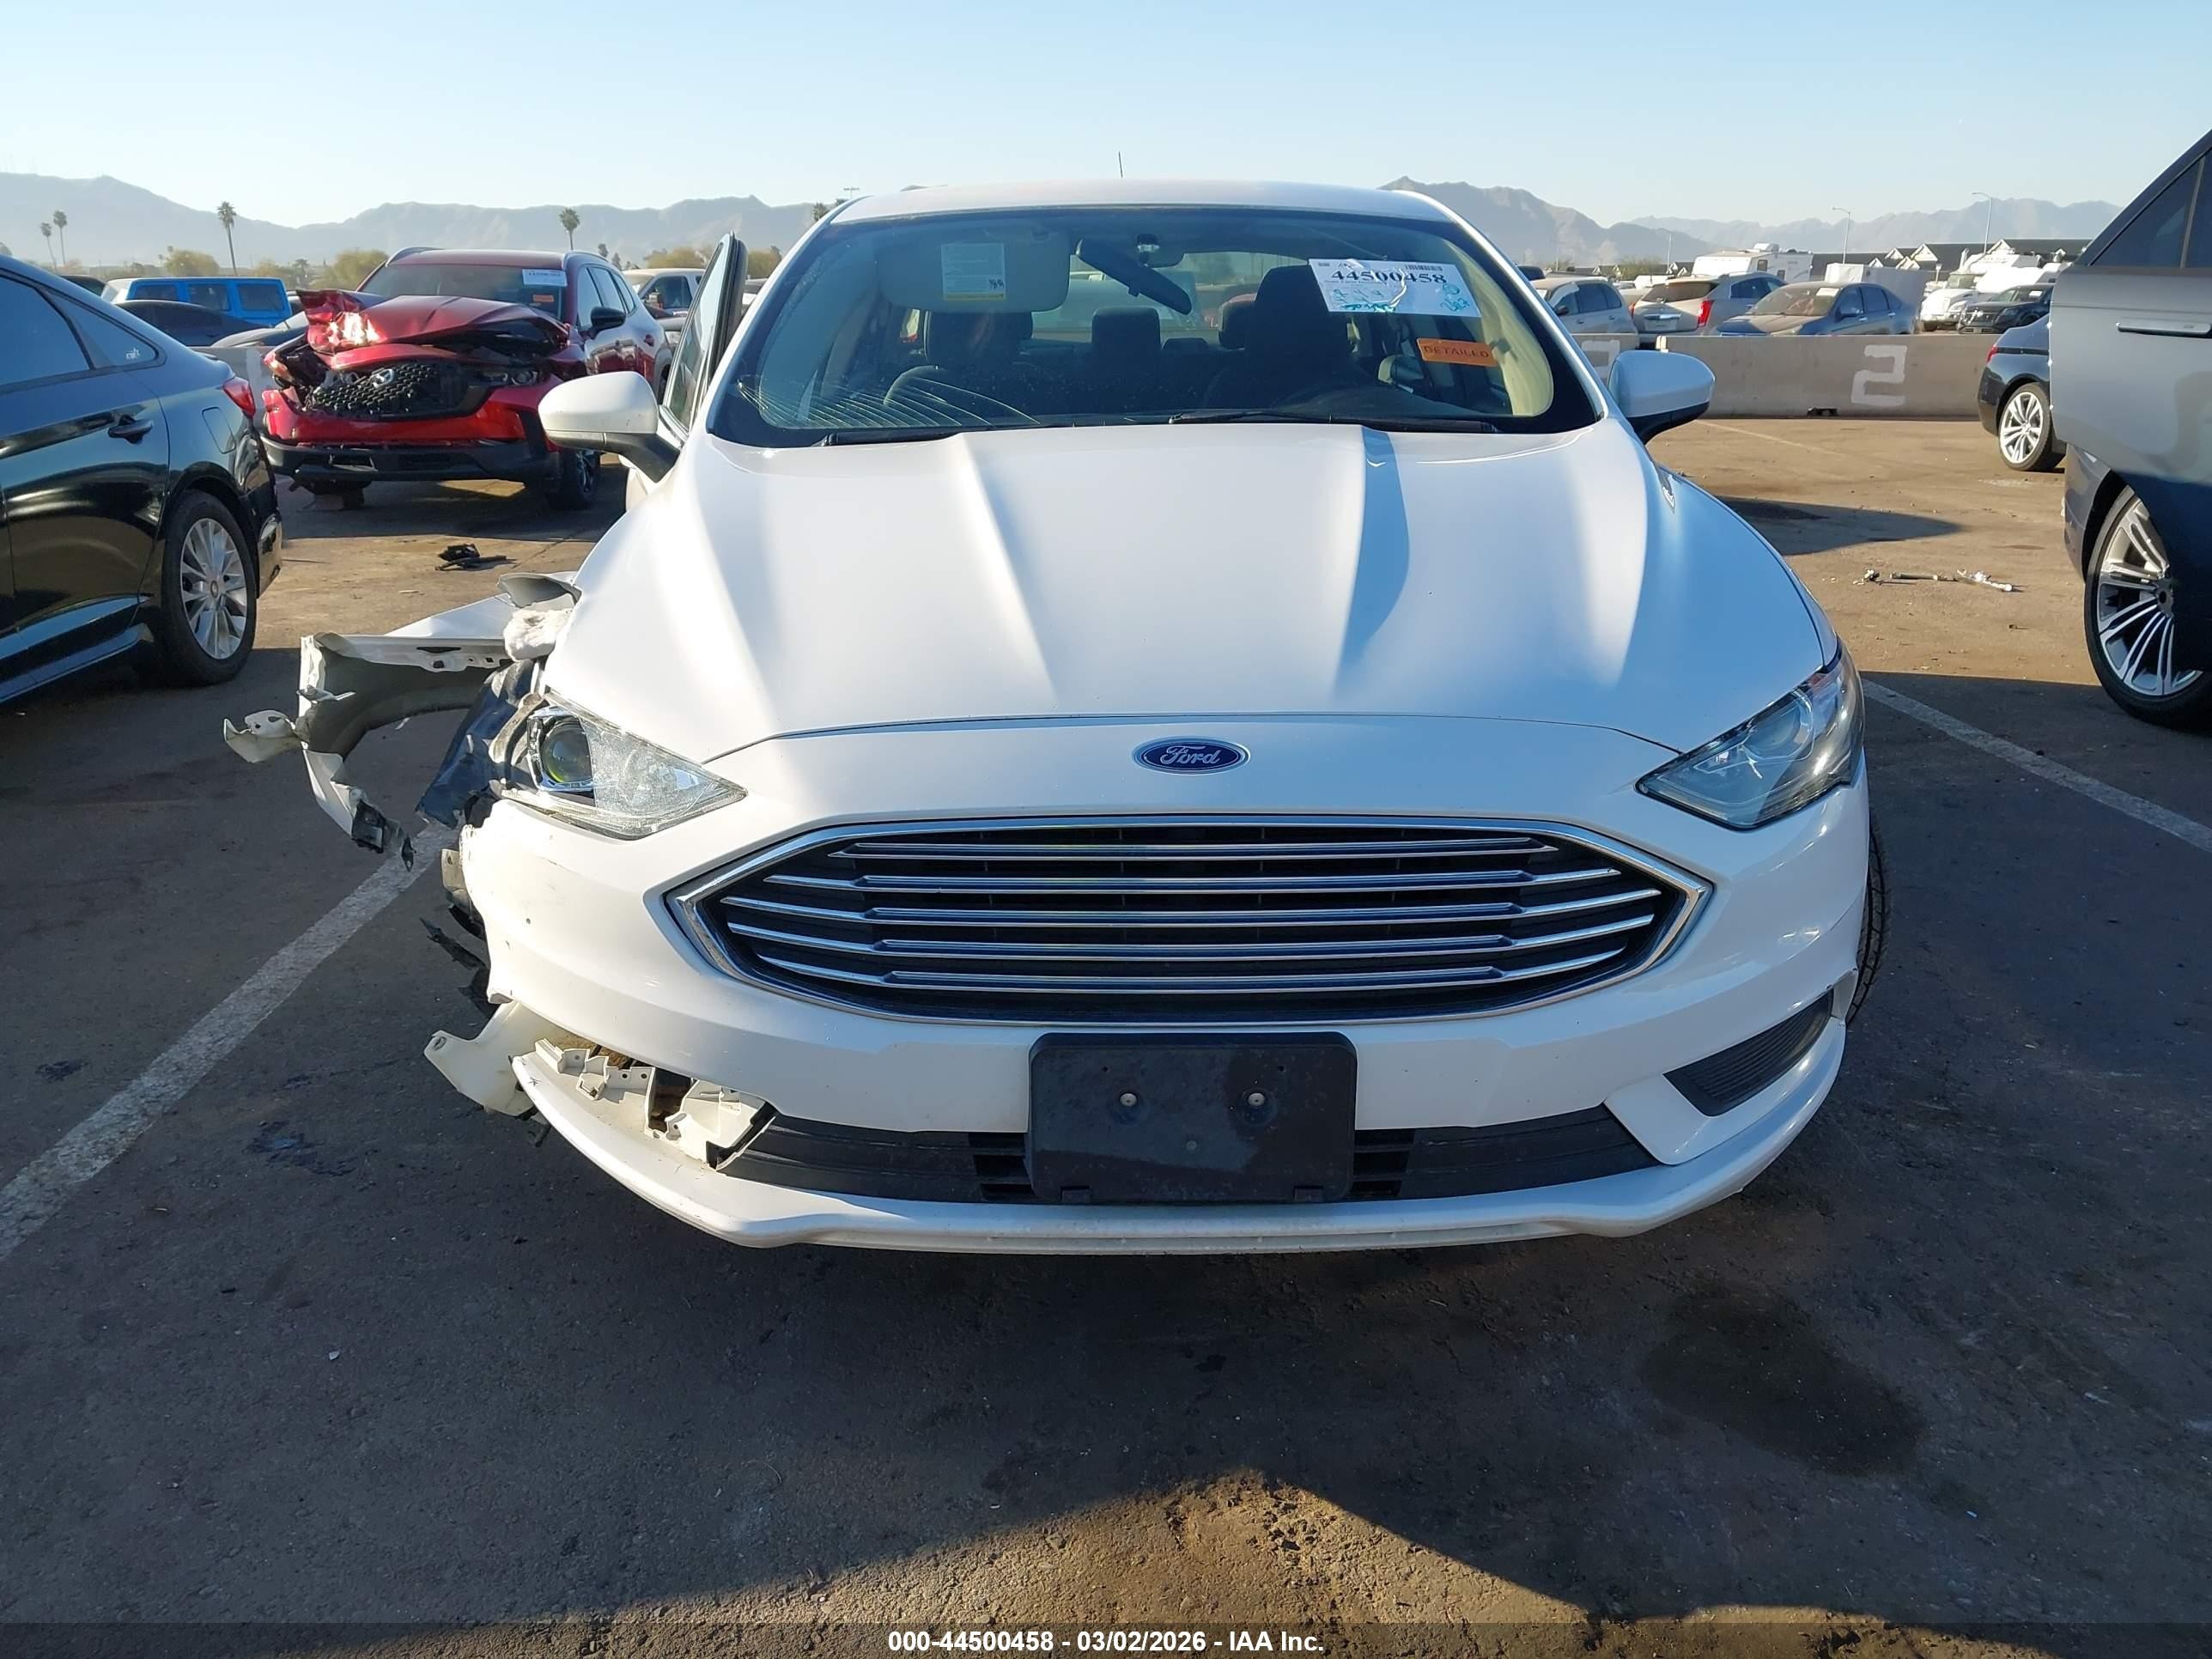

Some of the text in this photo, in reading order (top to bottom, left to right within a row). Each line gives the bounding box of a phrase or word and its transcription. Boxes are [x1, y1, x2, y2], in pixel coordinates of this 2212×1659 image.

[1332, 270, 1447, 283] 44500458
[1851, 344, 1907, 406] 2
[1160, 745, 1222, 764] Ford
